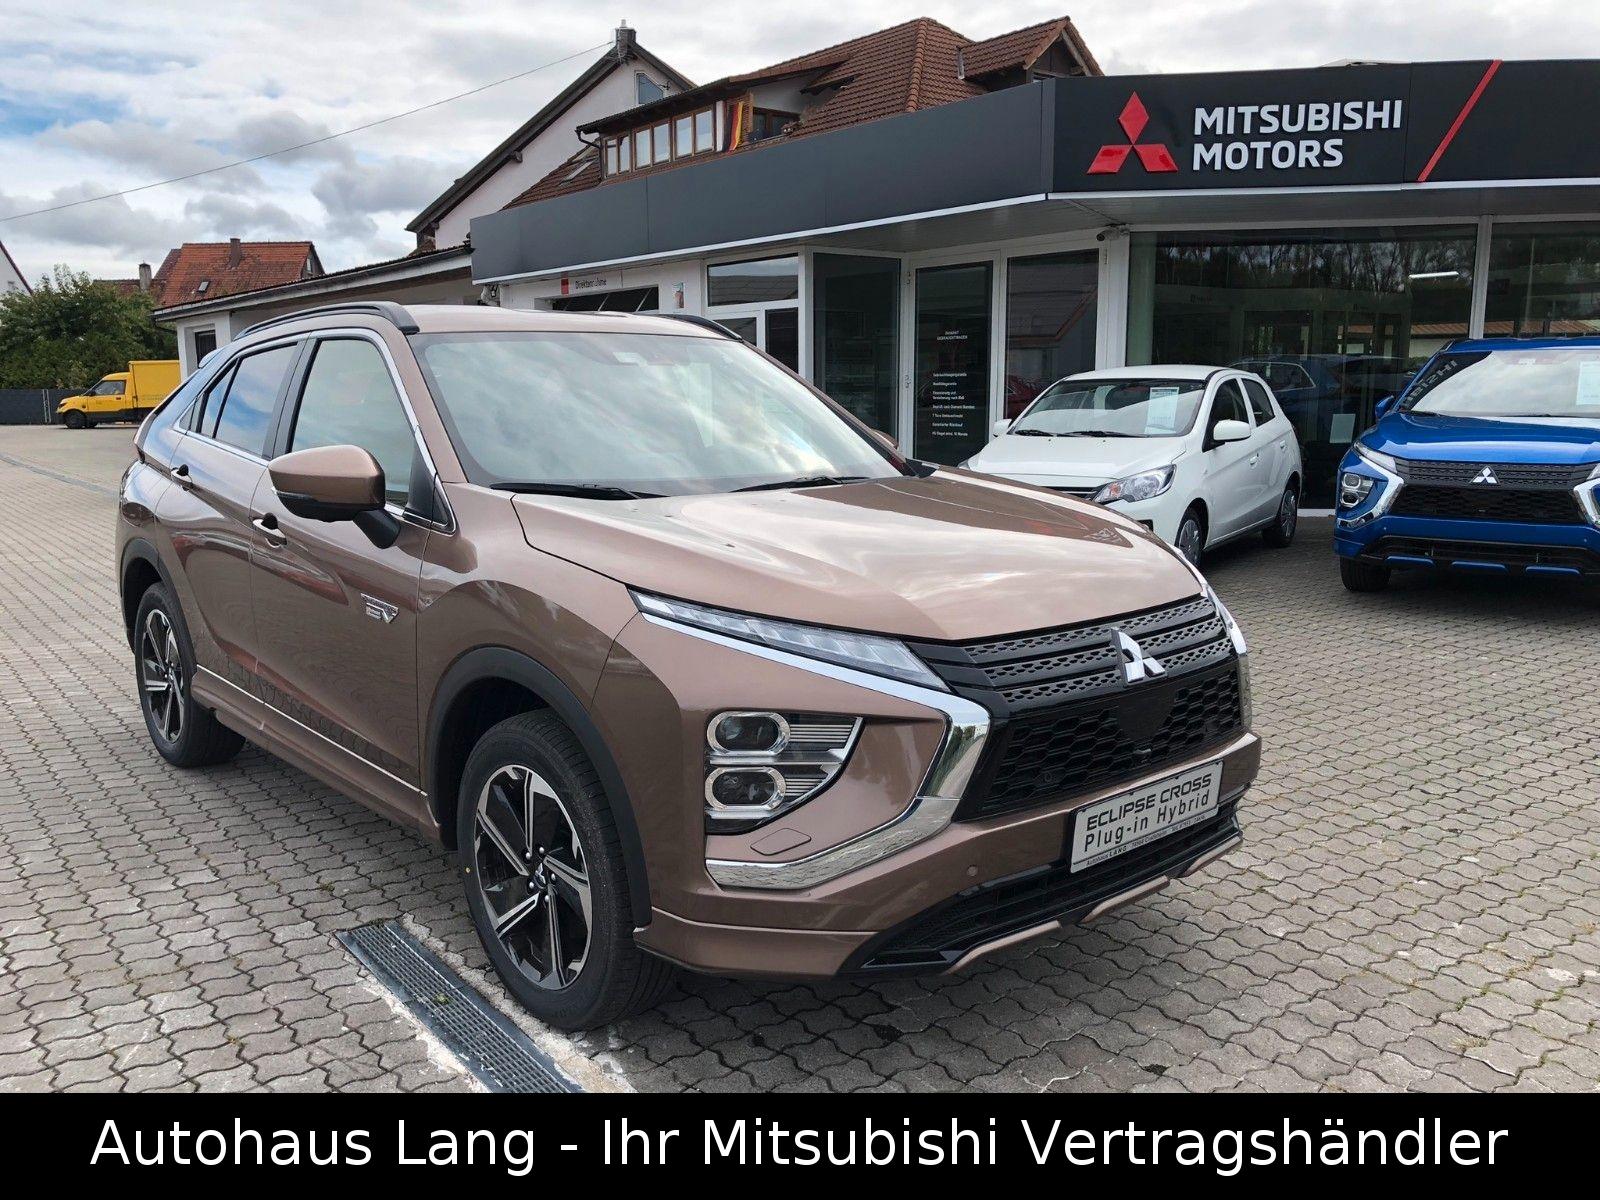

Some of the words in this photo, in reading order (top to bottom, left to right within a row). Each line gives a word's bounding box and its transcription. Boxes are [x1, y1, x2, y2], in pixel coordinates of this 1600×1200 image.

[1193, 99, 1403, 135] MITSUBISHI
[1192, 138, 1344, 171] MOTORS
[1084, 814, 1149, 852] Plug-in
[1156, 789, 1210, 824] Hybrid
[1086, 793, 1157, 832] ECLIPSE
[1160, 773, 1212, 804] CROSS
[1109, 845, 1127, 858] LANG
